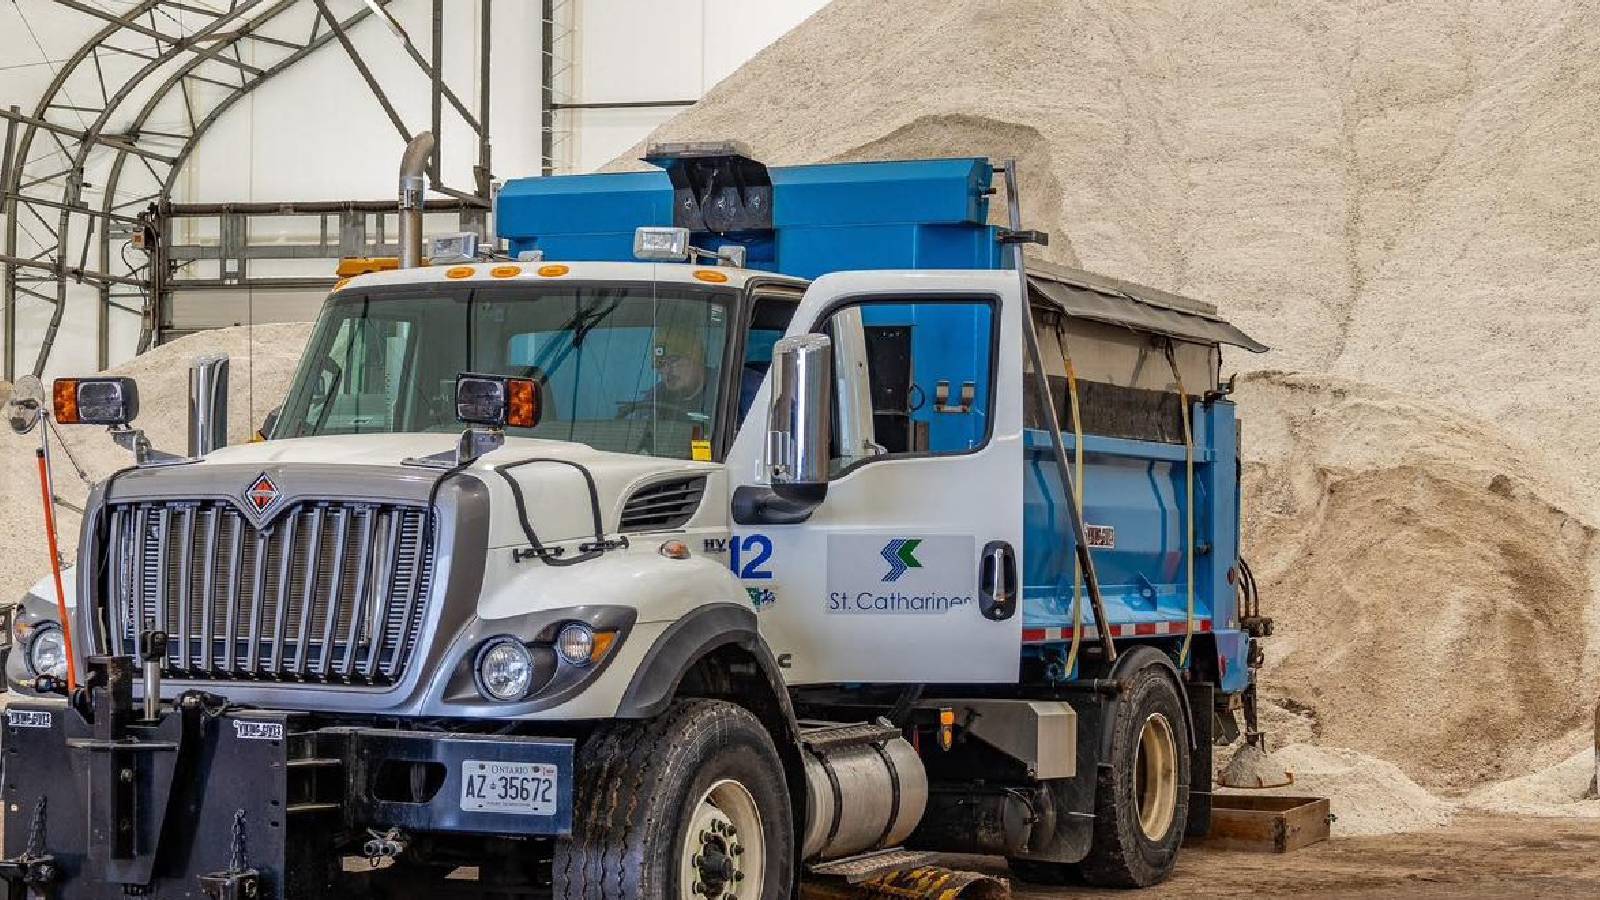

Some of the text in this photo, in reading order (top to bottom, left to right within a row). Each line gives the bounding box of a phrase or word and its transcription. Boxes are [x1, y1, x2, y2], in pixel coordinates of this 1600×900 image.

[729, 533, 772, 578] 12
[830, 592, 851, 610] St.
[491, 765, 529, 774] ONTARIO
[466, 774, 553, 803] AZ 35672
